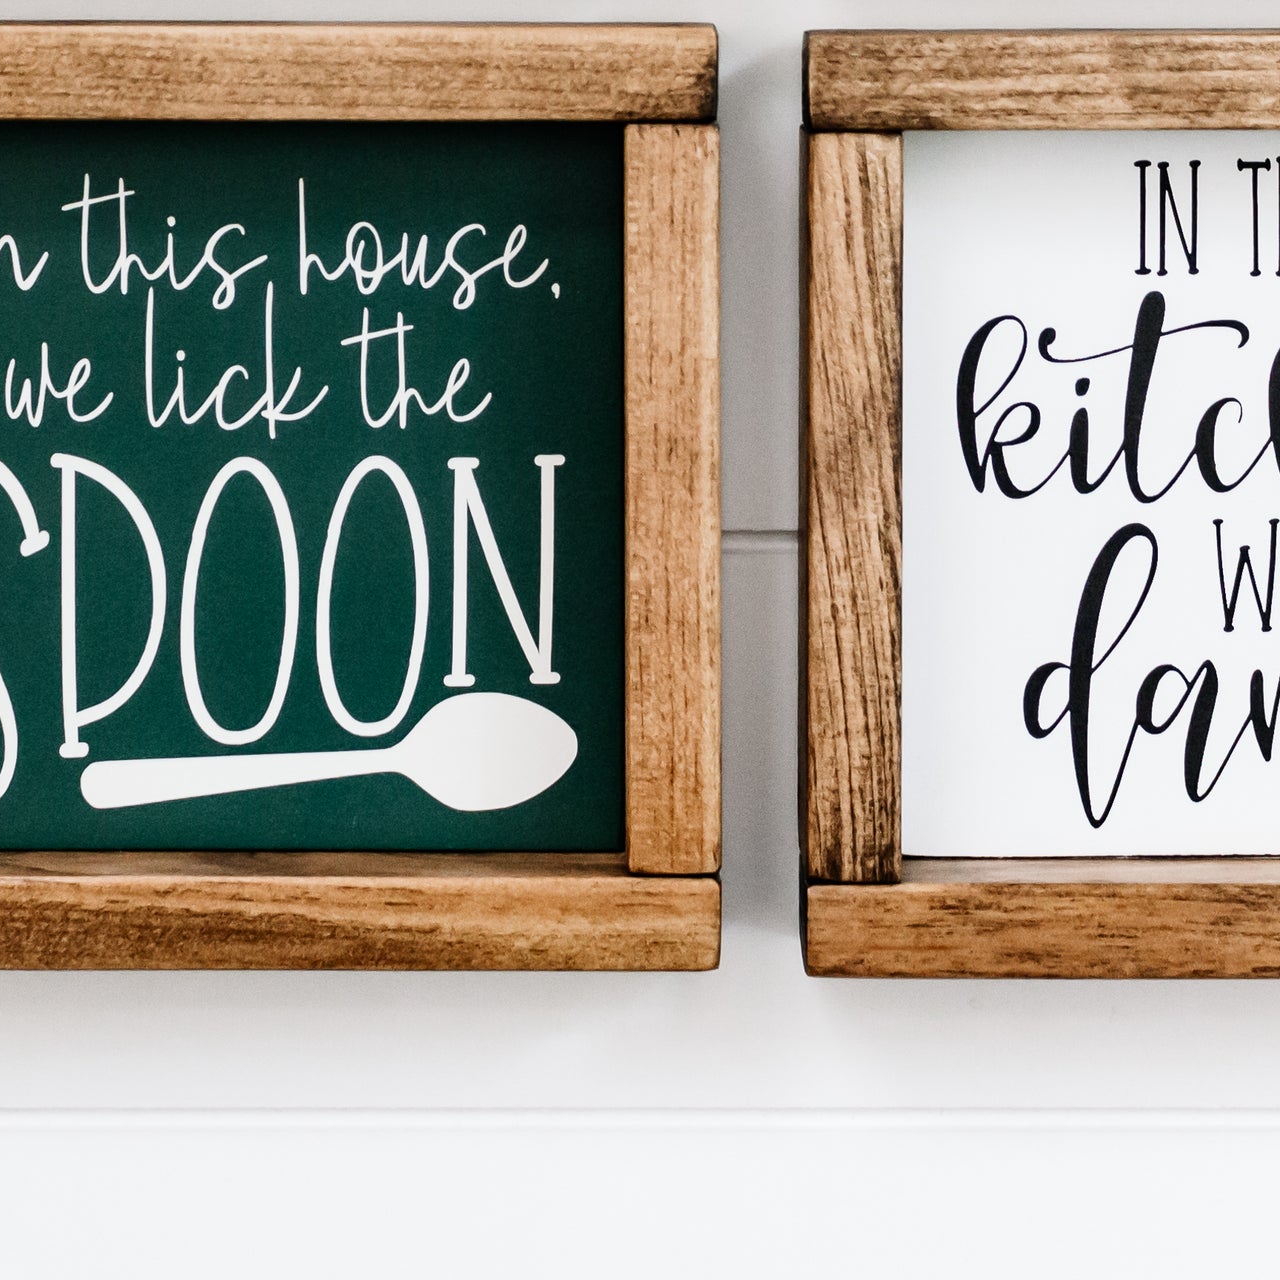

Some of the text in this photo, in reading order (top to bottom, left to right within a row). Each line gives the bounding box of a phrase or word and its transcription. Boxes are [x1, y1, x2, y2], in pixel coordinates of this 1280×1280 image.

[61, 173, 268, 310] this
[298, 177, 562, 310] house,
[1133, 159, 1200, 277] IN
[4, 280, 492, 440] we lick the
